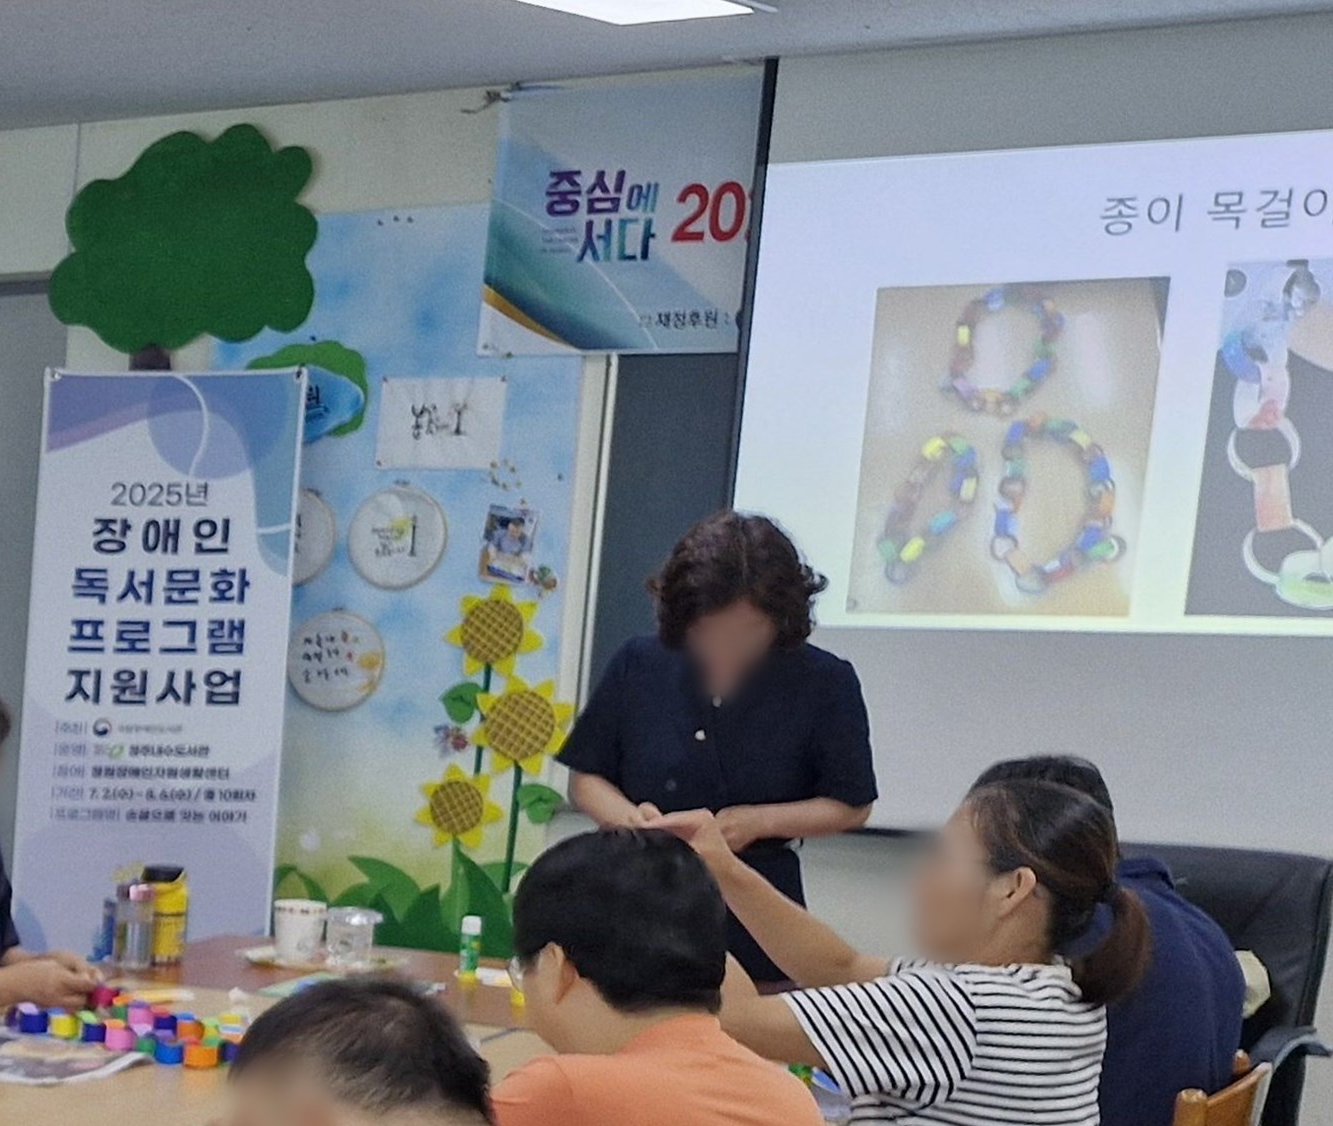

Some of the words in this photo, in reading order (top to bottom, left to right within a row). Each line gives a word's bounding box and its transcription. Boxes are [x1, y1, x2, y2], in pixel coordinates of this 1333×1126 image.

[545, 170, 660, 217] 중심에
[672, 181, 751, 243] 20
[1100, 193, 1185, 237] 종이
[576, 217, 656, 263] 서다
[111, 482, 209, 507] 2025년
[92, 518, 231, 556] 장애인
[71, 567, 250, 606] 독서문화
[68, 618, 246, 656] 프로그램
[65, 669, 242, 706] 지원사업
